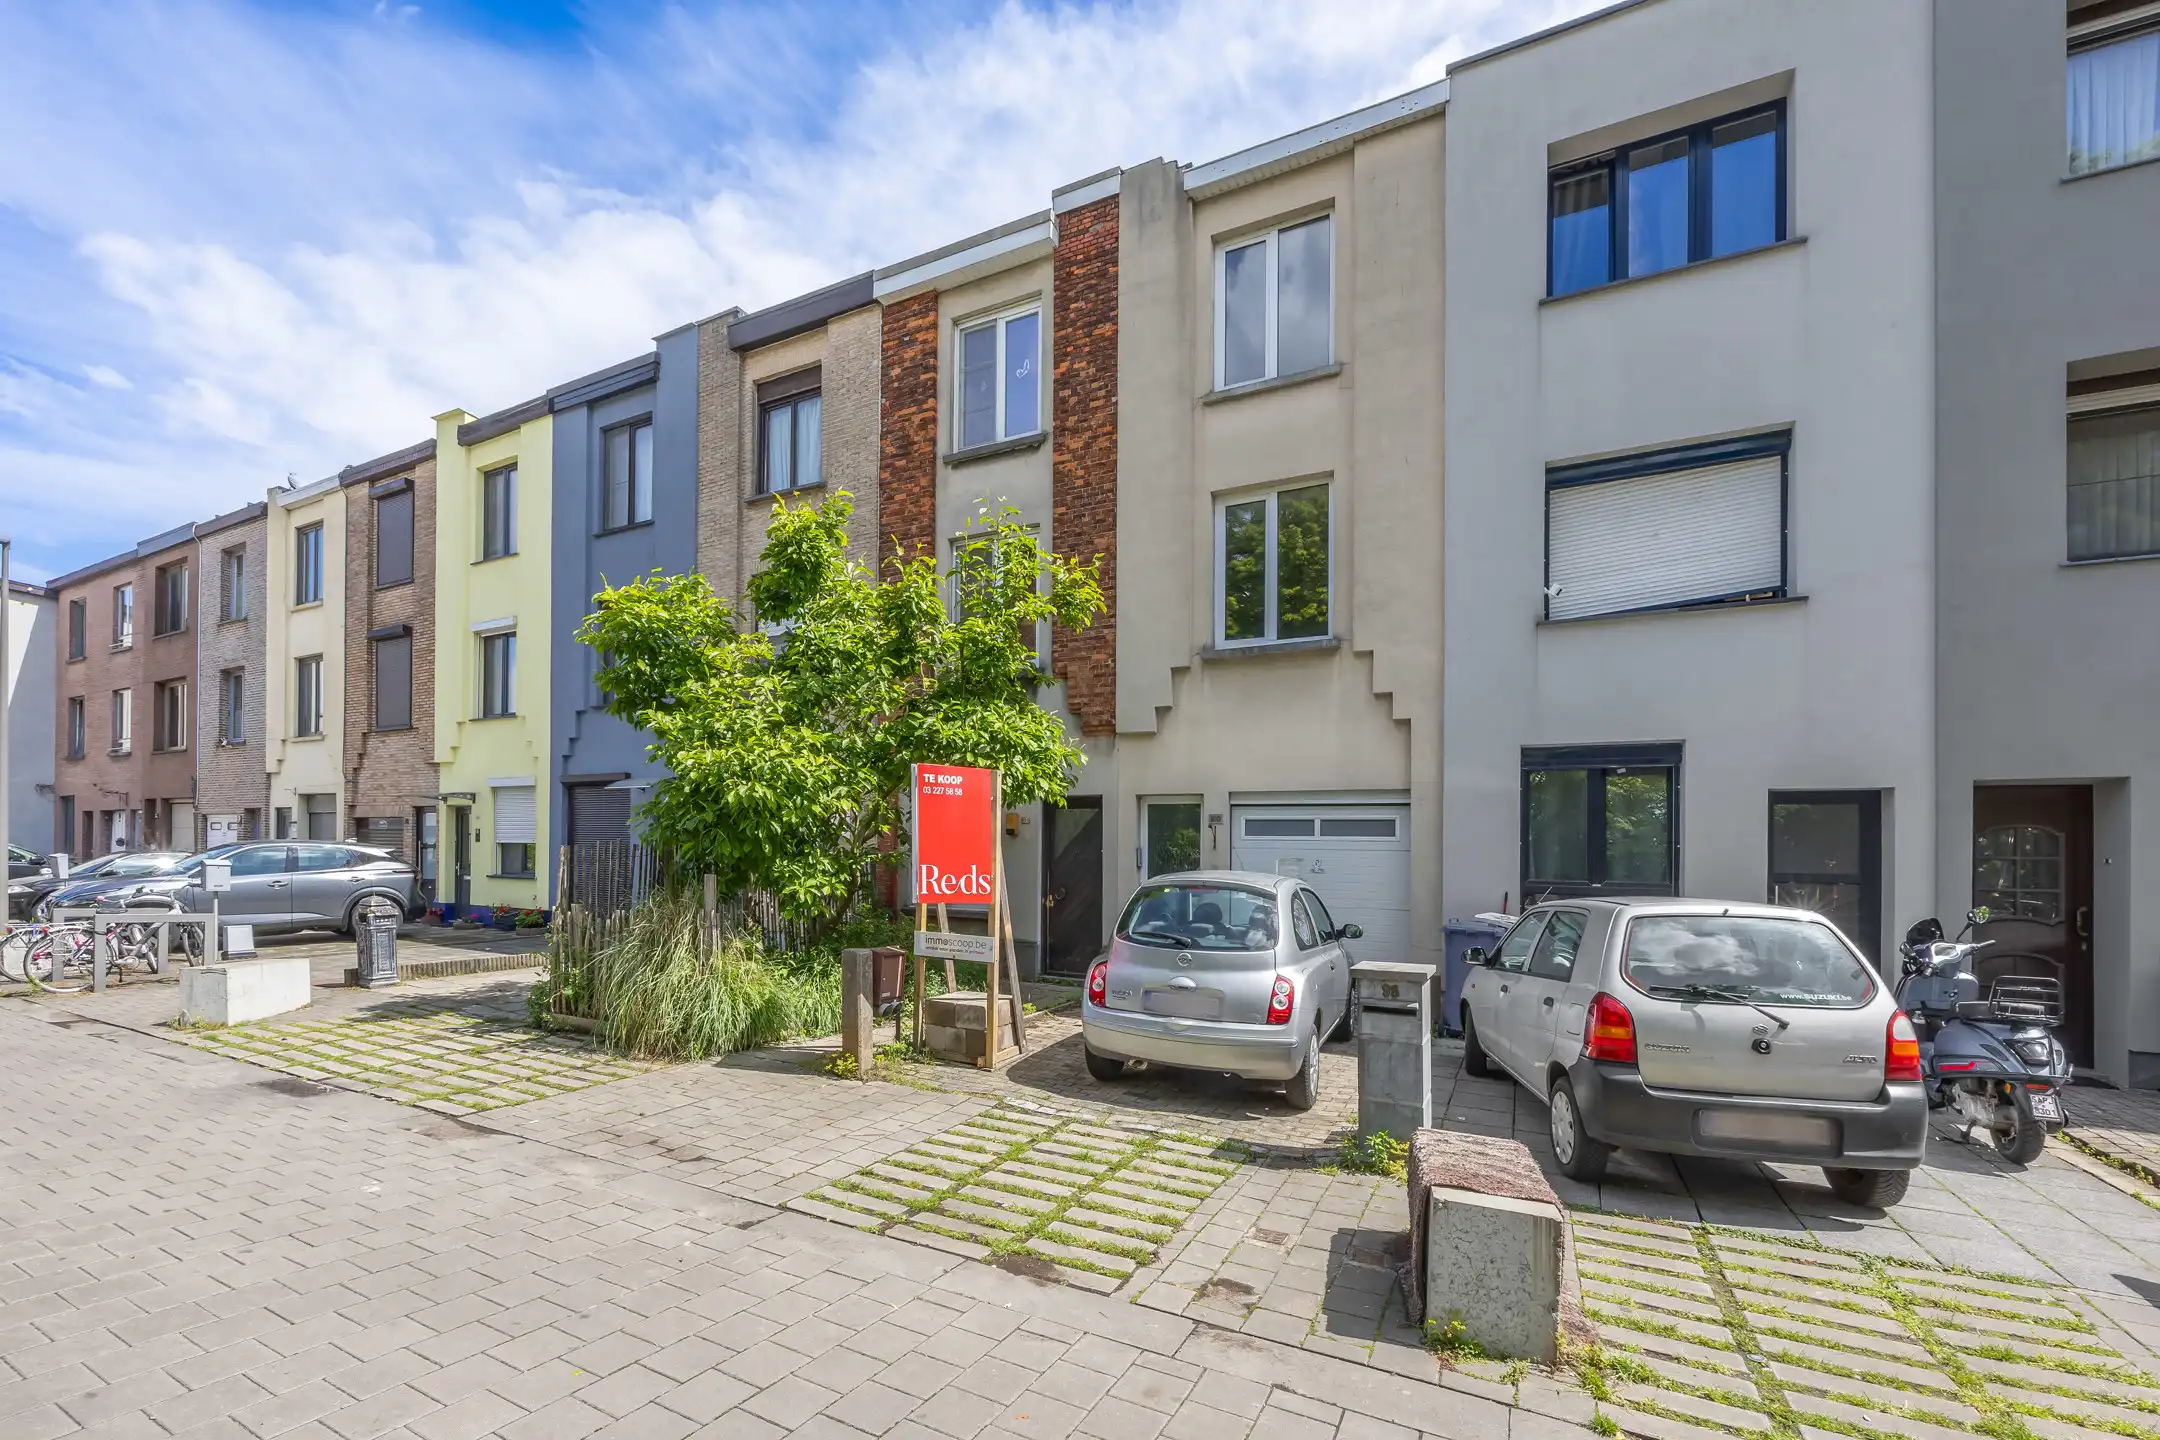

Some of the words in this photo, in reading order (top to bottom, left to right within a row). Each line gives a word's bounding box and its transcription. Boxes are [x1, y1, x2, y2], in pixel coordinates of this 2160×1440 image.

[923, 773, 936, 783] TE
[938, 774, 963, 784] KOOP
[922, 785, 931, 794] 03
[932, 786, 944, 795] 227
[945, 787, 954, 795] 58
[954, 787, 963, 796] 58
[919, 864, 991, 895] Reds
[925, 934, 987, 950] immoscoop.be
